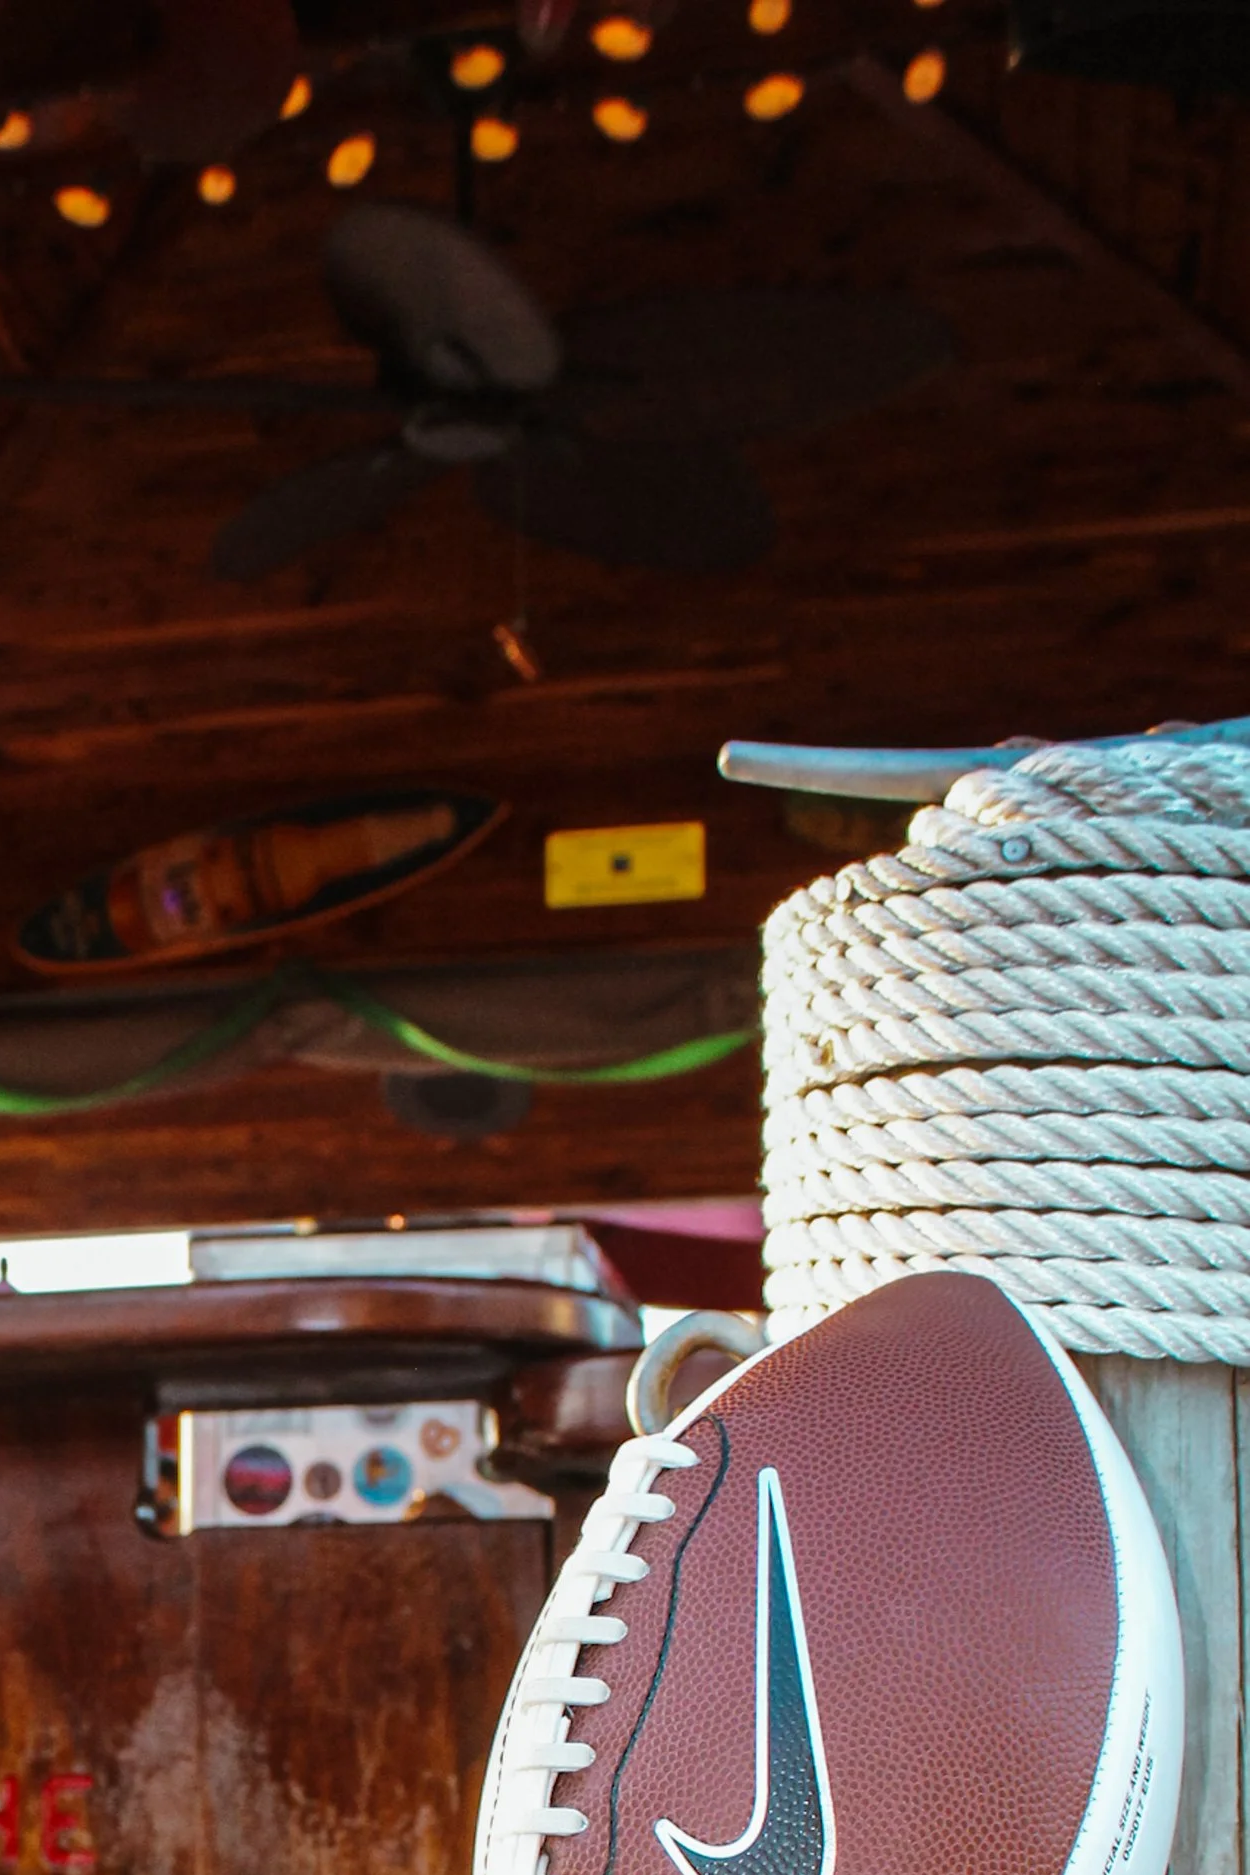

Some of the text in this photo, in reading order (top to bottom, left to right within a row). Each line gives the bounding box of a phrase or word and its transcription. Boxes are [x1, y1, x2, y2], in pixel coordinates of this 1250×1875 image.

[1118, 1793, 1134, 1831] SIZE
[1129, 1755, 1141, 1793] AND
[1137, 1688, 1152, 1753] WEIGHT
